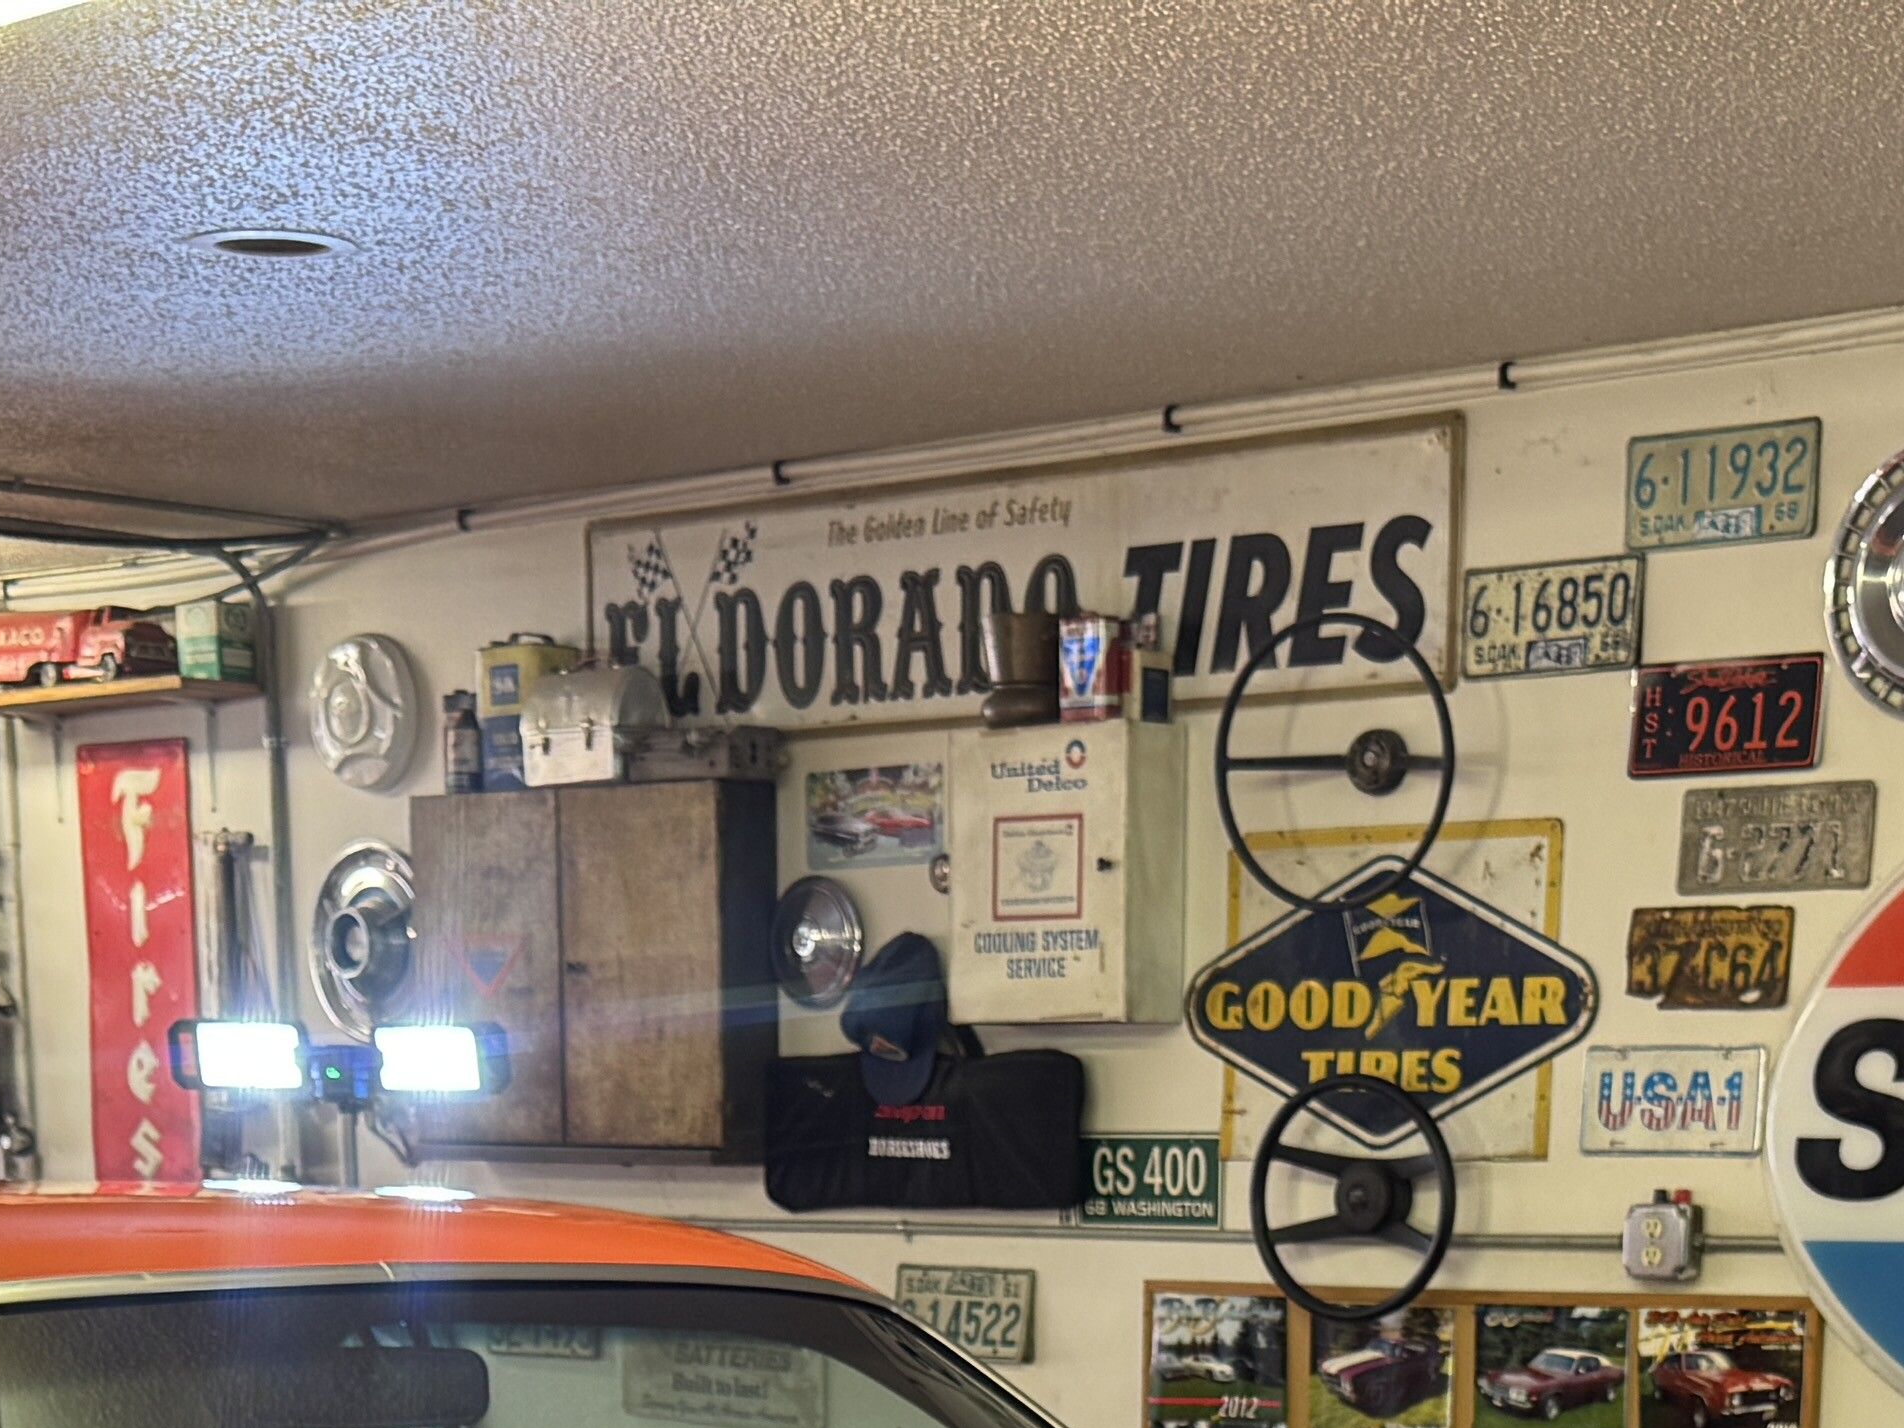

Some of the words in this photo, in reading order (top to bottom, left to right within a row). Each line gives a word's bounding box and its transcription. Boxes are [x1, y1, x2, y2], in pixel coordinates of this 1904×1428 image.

[827, 519, 858, 548] The
[863, 511, 926, 544] Golden
[930, 508, 971, 537] Line
[974, 504, 997, 532] of
[1003, 495, 1073, 530] Safety
[1122, 514, 1434, 678] TIRES
[1685, 690, 1804, 752] 9612
[990, 759, 1061, 780] United
[1027, 776, 1089, 794] Delco
[973, 931, 1036, 954] COOLING
[1041, 929, 1100, 951] SYSTEM
[1006, 956, 1066, 980] SERVICE
[1301, 1047, 1463, 1094] TIRES
[1092, 1147, 1136, 1196] GS
[1142, 1145, 1209, 1197] 400
[1110, 1199, 1214, 1218] WASHINGTON
[1218, 1395, 1259, 1419] 2012
